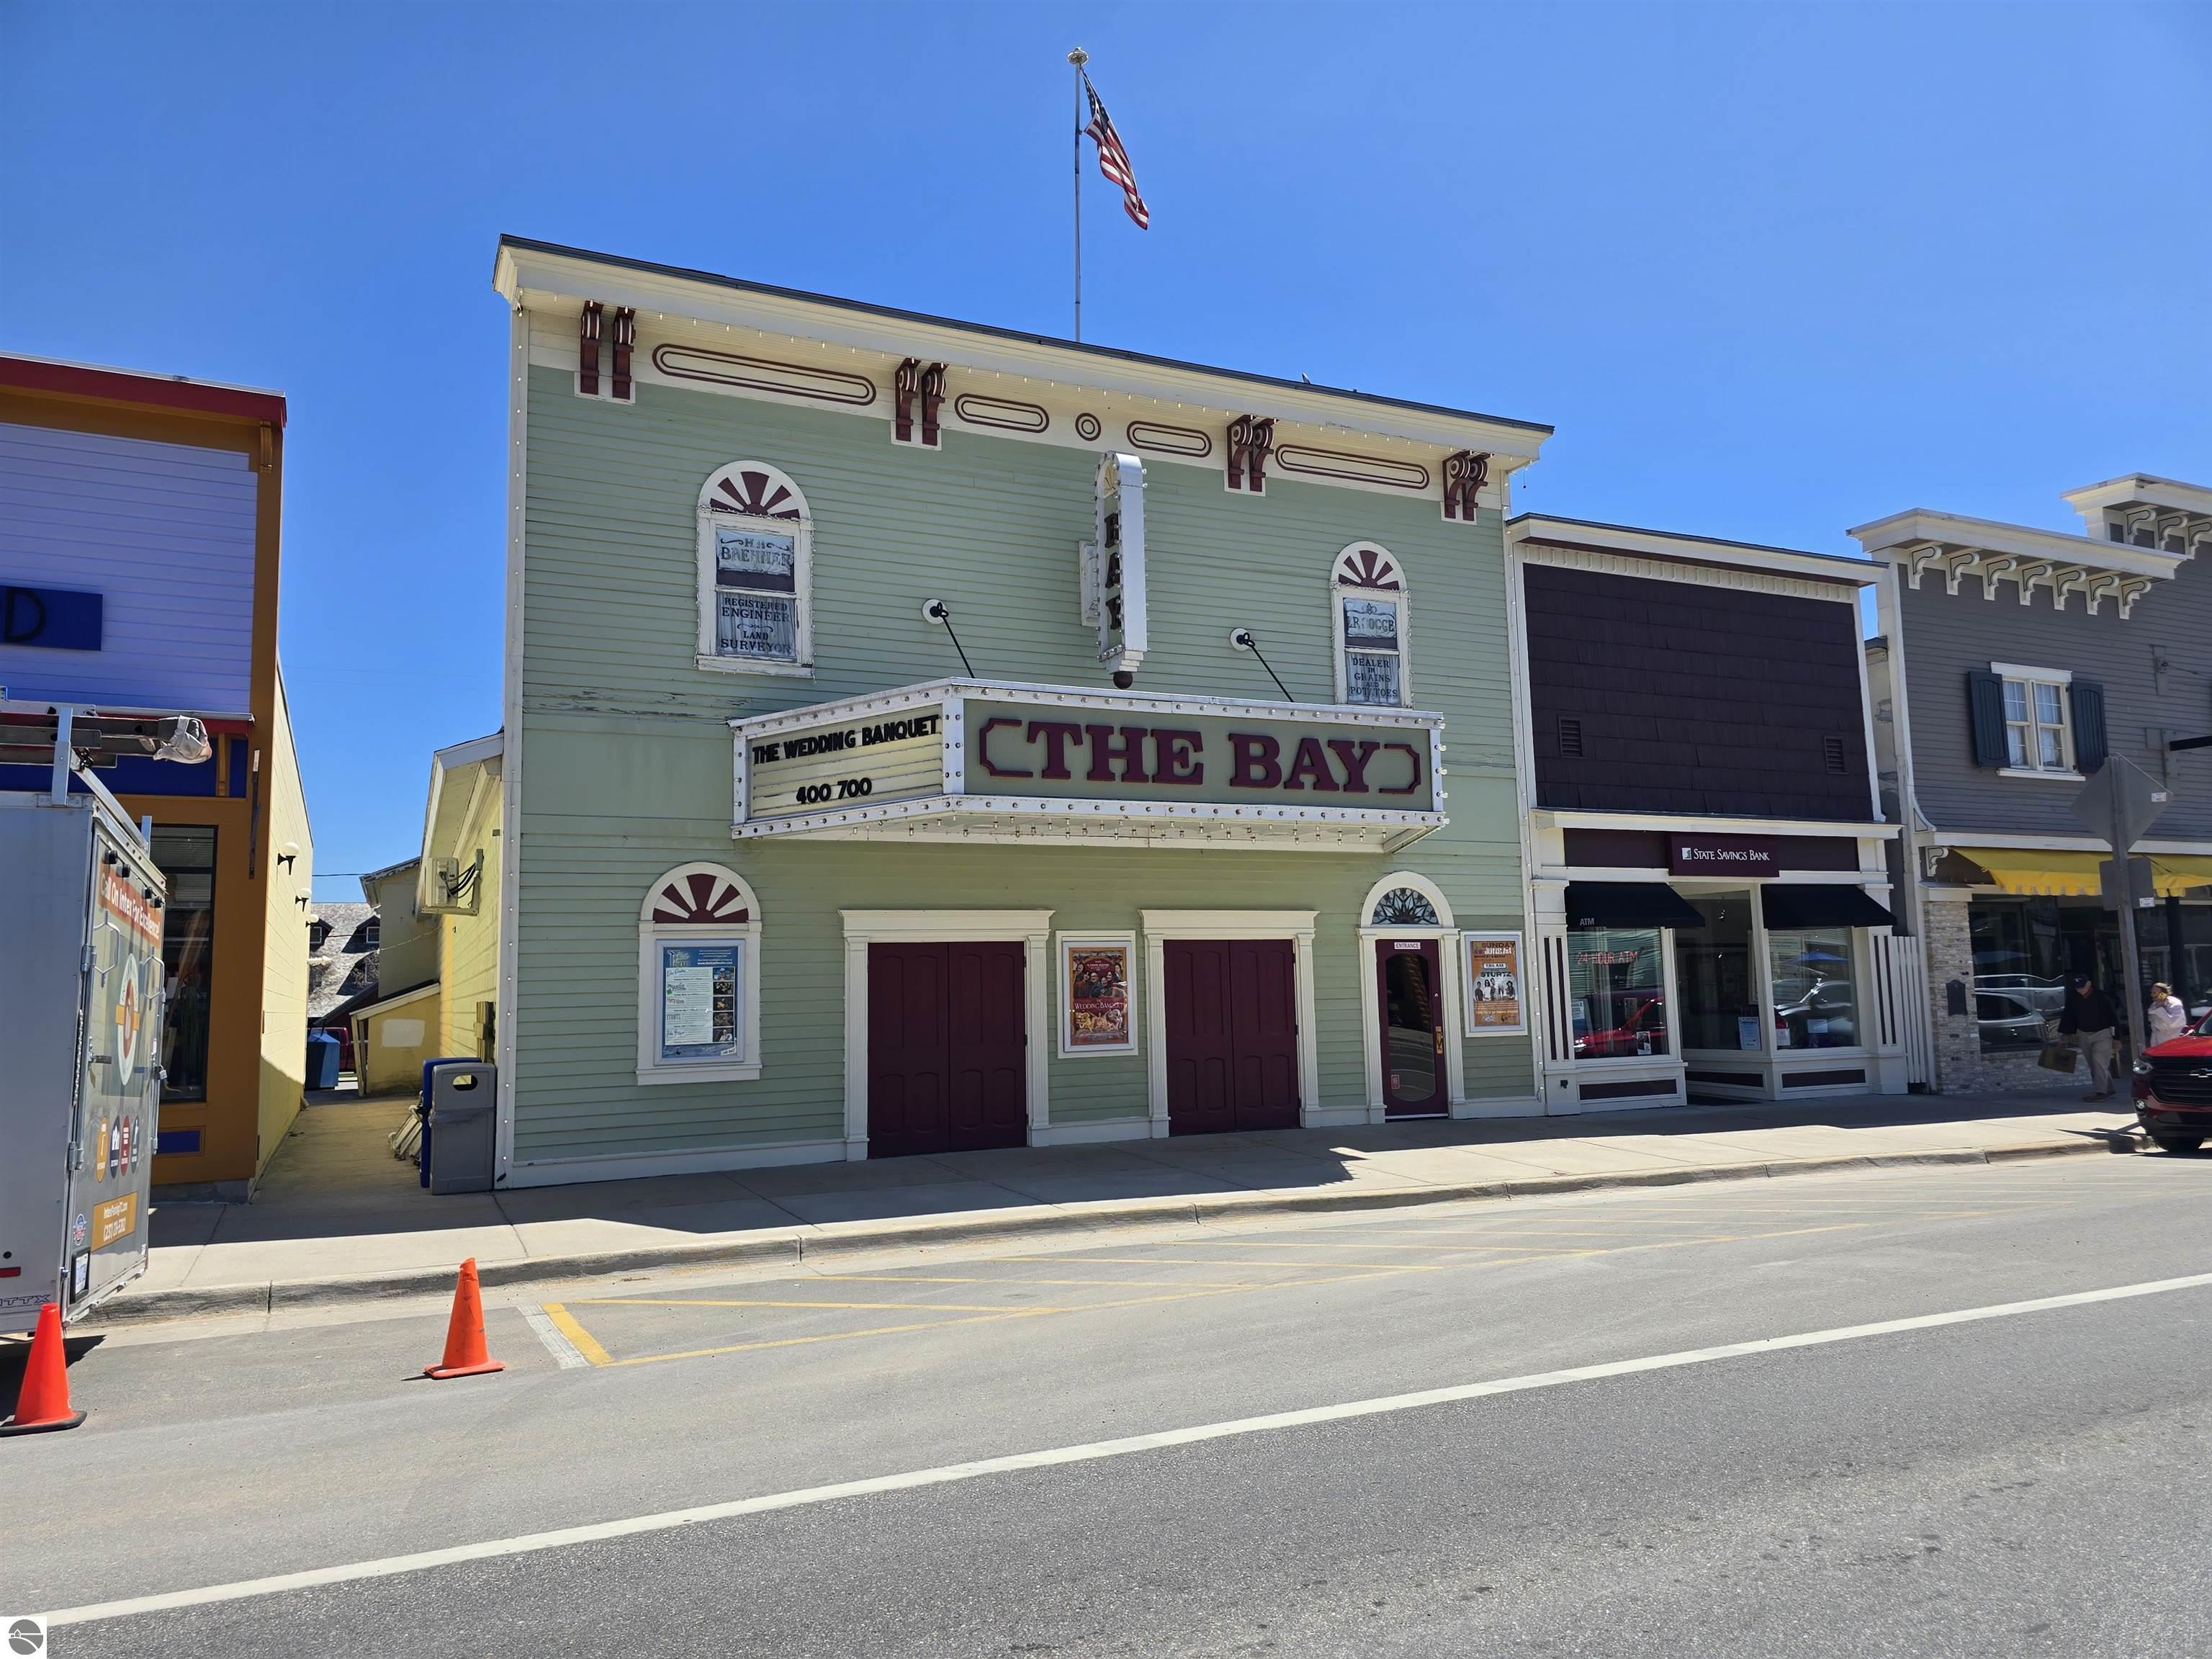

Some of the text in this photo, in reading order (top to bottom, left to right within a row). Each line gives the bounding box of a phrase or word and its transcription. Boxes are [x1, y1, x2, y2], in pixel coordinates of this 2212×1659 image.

[724, 598, 787, 611] REGISTERED
[721, 607, 789, 622] ENGINEER
[743, 631, 768, 640] LAND
[721, 639, 792, 654] SURVEYOR
[1353, 657, 1390, 667] DEALER
[1354, 673, 1390, 683] GRAINS
[1349, 687, 1398, 698] POTATOES
[752, 714, 939, 764] THE WEDDING BANQUET
[1027, 721, 1380, 793] THE BAY
[796, 777, 872, 804] 400 700
[1694, 848, 1770, 861] STATE SAVINGS BANK
[111, 881, 119, 908] On
[1580, 917, 1595, 926] ATM
[1618, 950, 1640, 963] ATM
